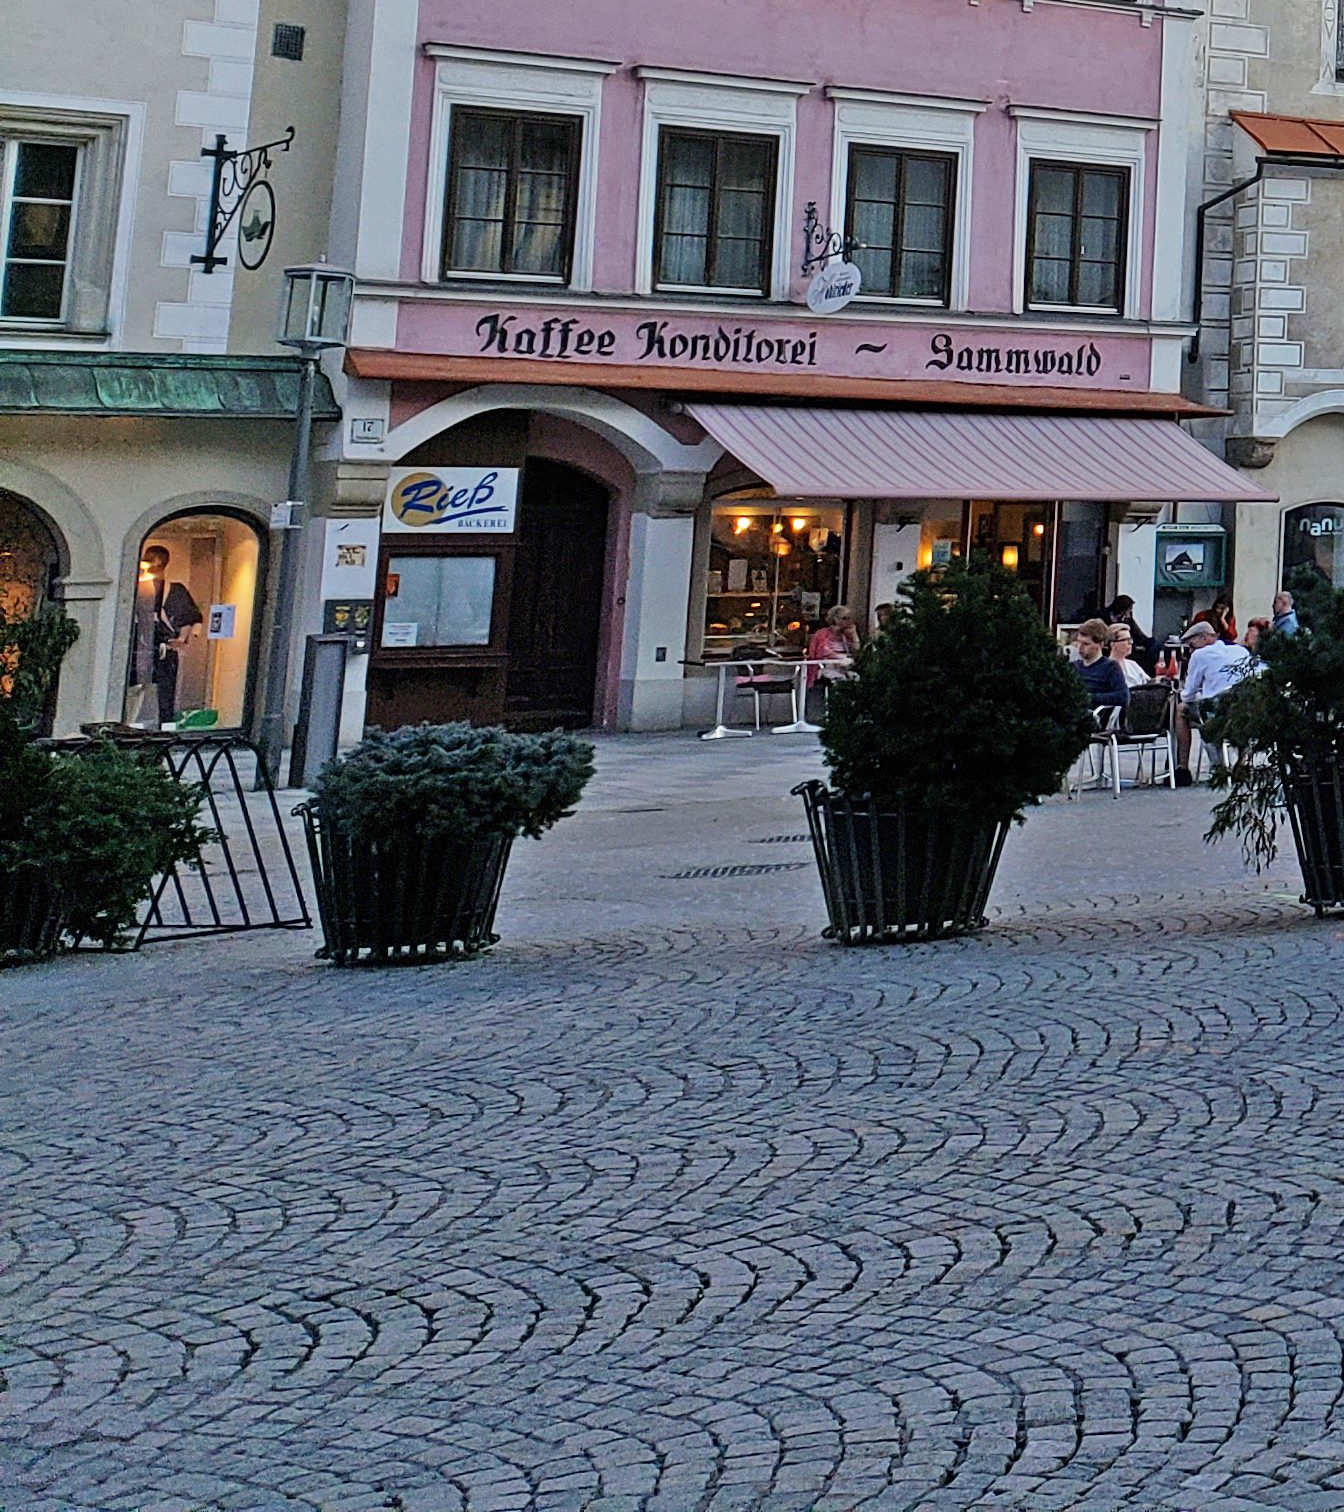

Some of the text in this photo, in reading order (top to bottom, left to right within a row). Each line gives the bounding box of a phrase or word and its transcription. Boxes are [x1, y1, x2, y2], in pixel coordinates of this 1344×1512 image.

[475, 313, 616, 359] Kaffee
[635, 321, 818, 366] Konditorei
[925, 333, 1102, 376] Sammwald
[363, 421, 374, 432] 17
[1299, 517, 1344, 537] nanu
